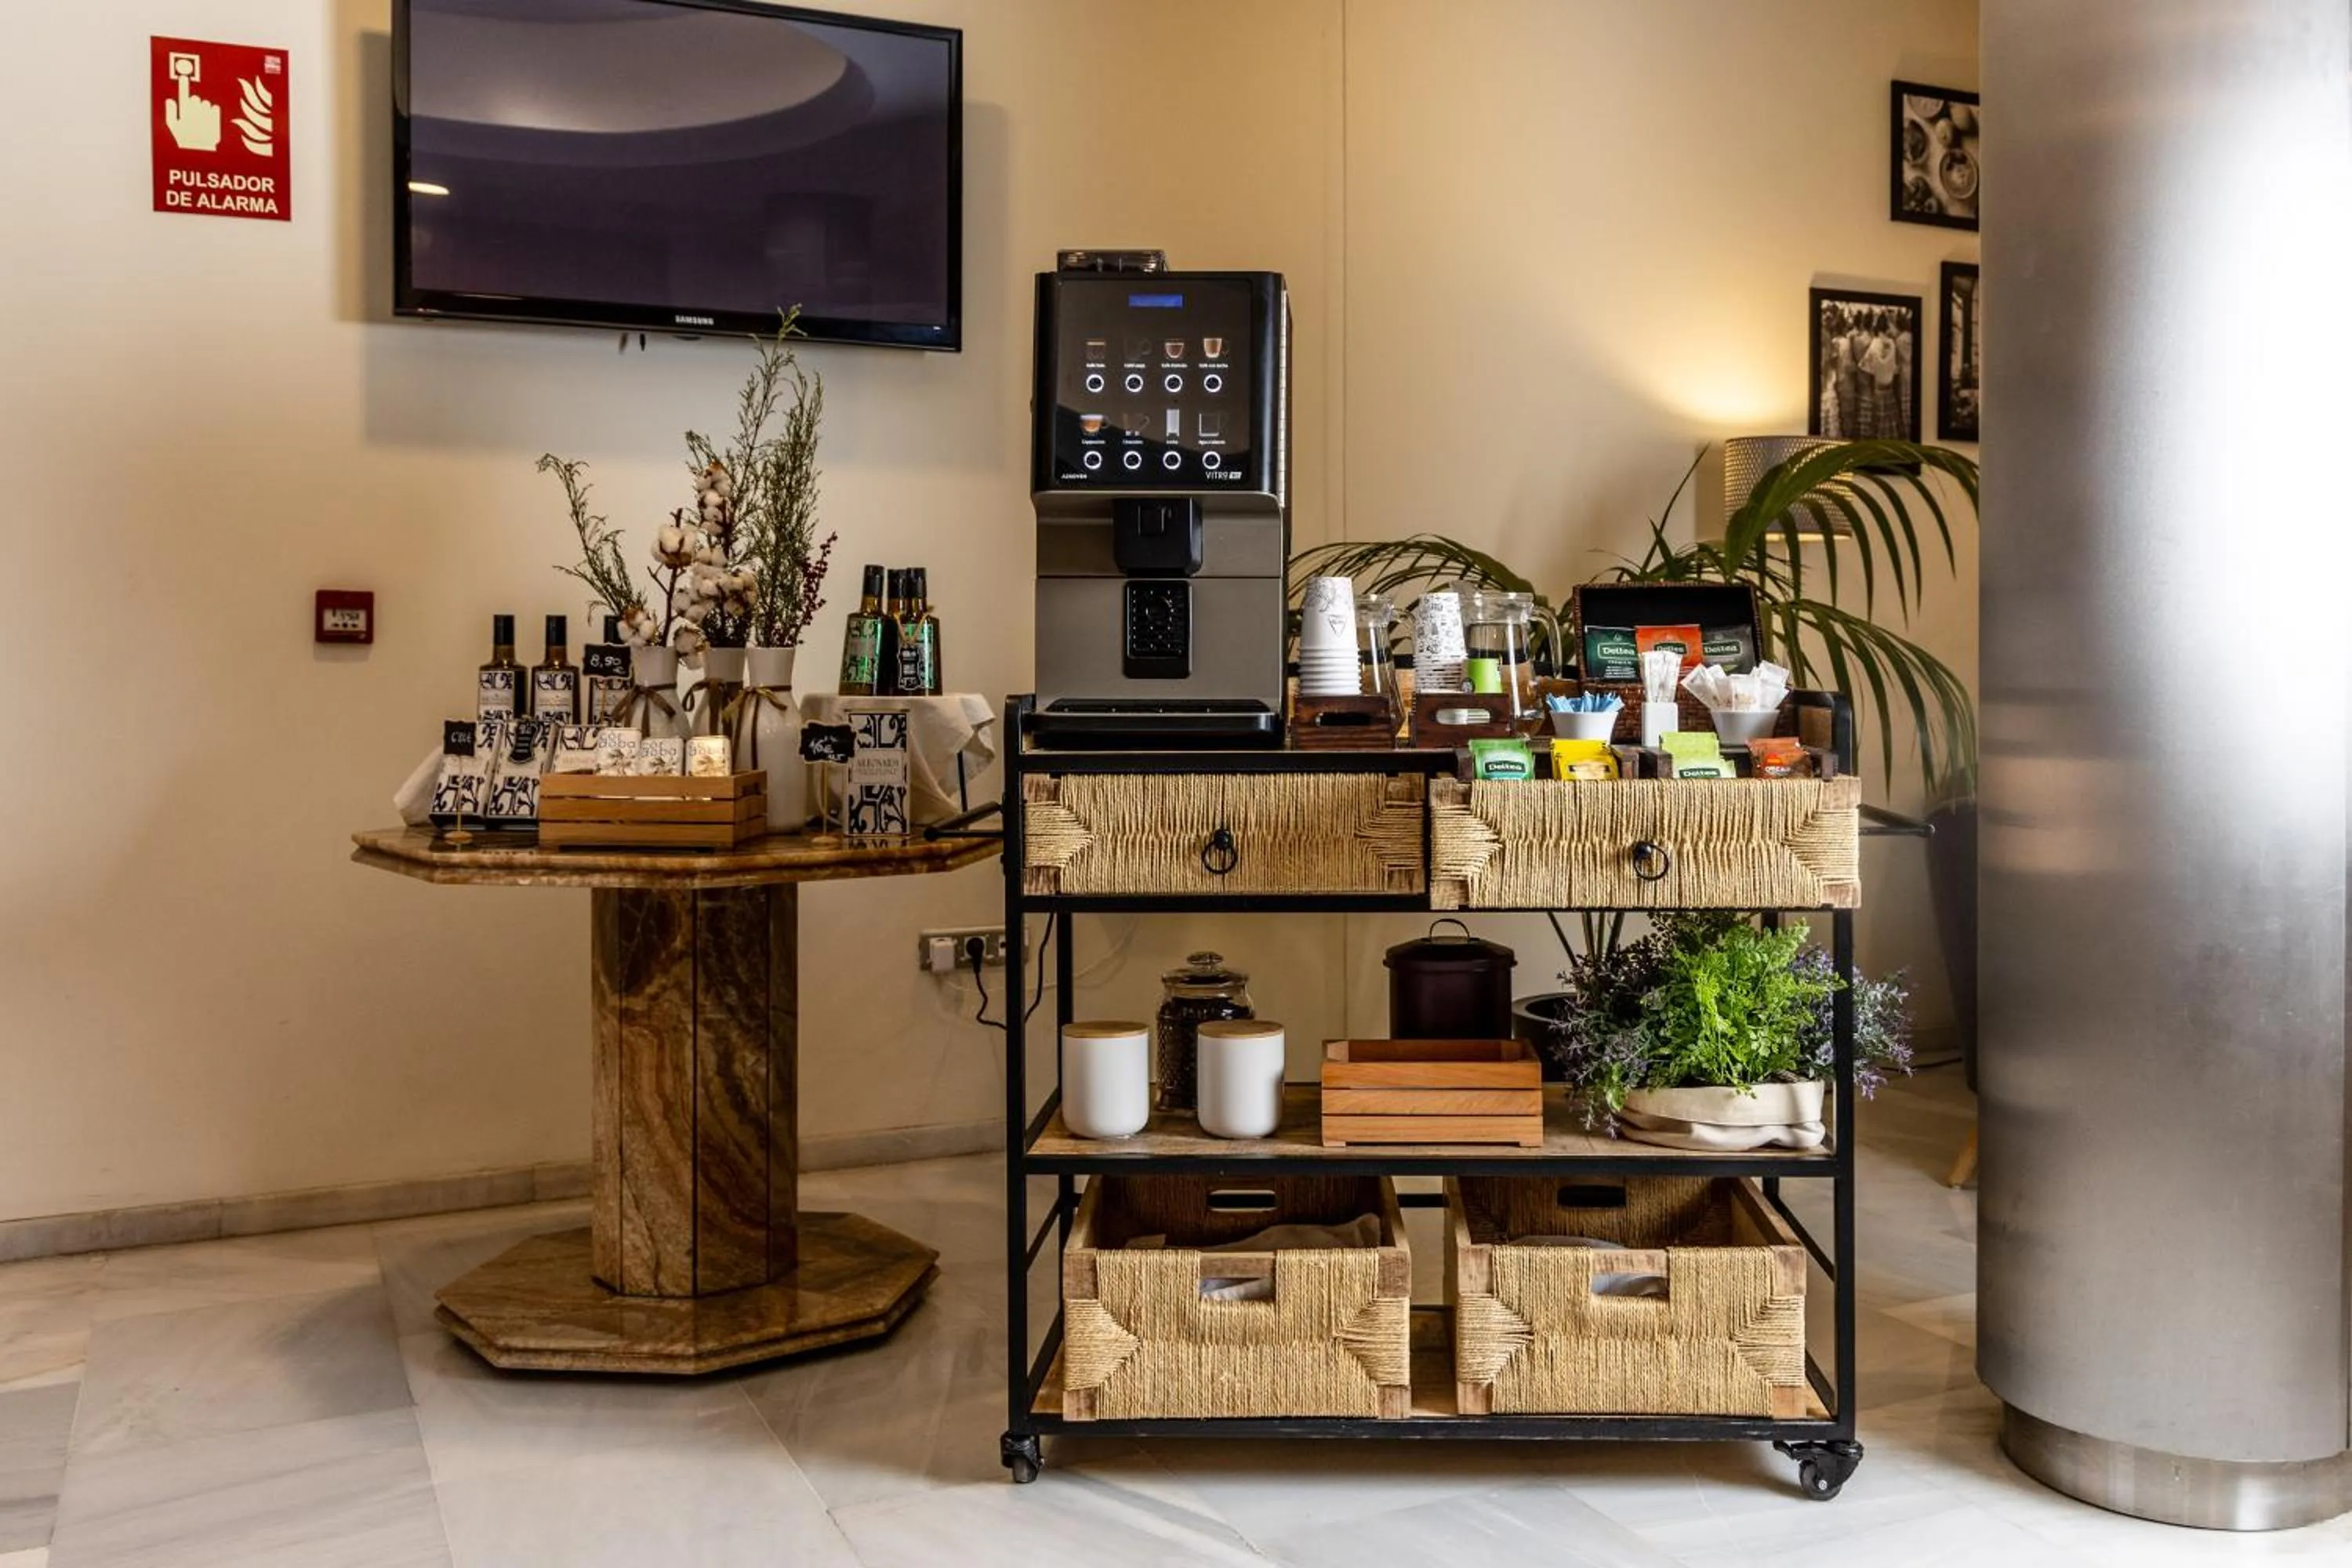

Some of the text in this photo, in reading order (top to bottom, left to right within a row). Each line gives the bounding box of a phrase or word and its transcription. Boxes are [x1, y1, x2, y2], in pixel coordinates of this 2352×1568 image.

[169, 169, 274, 193] PULSADOR
[166, 191, 278, 214] DE ALARMA
